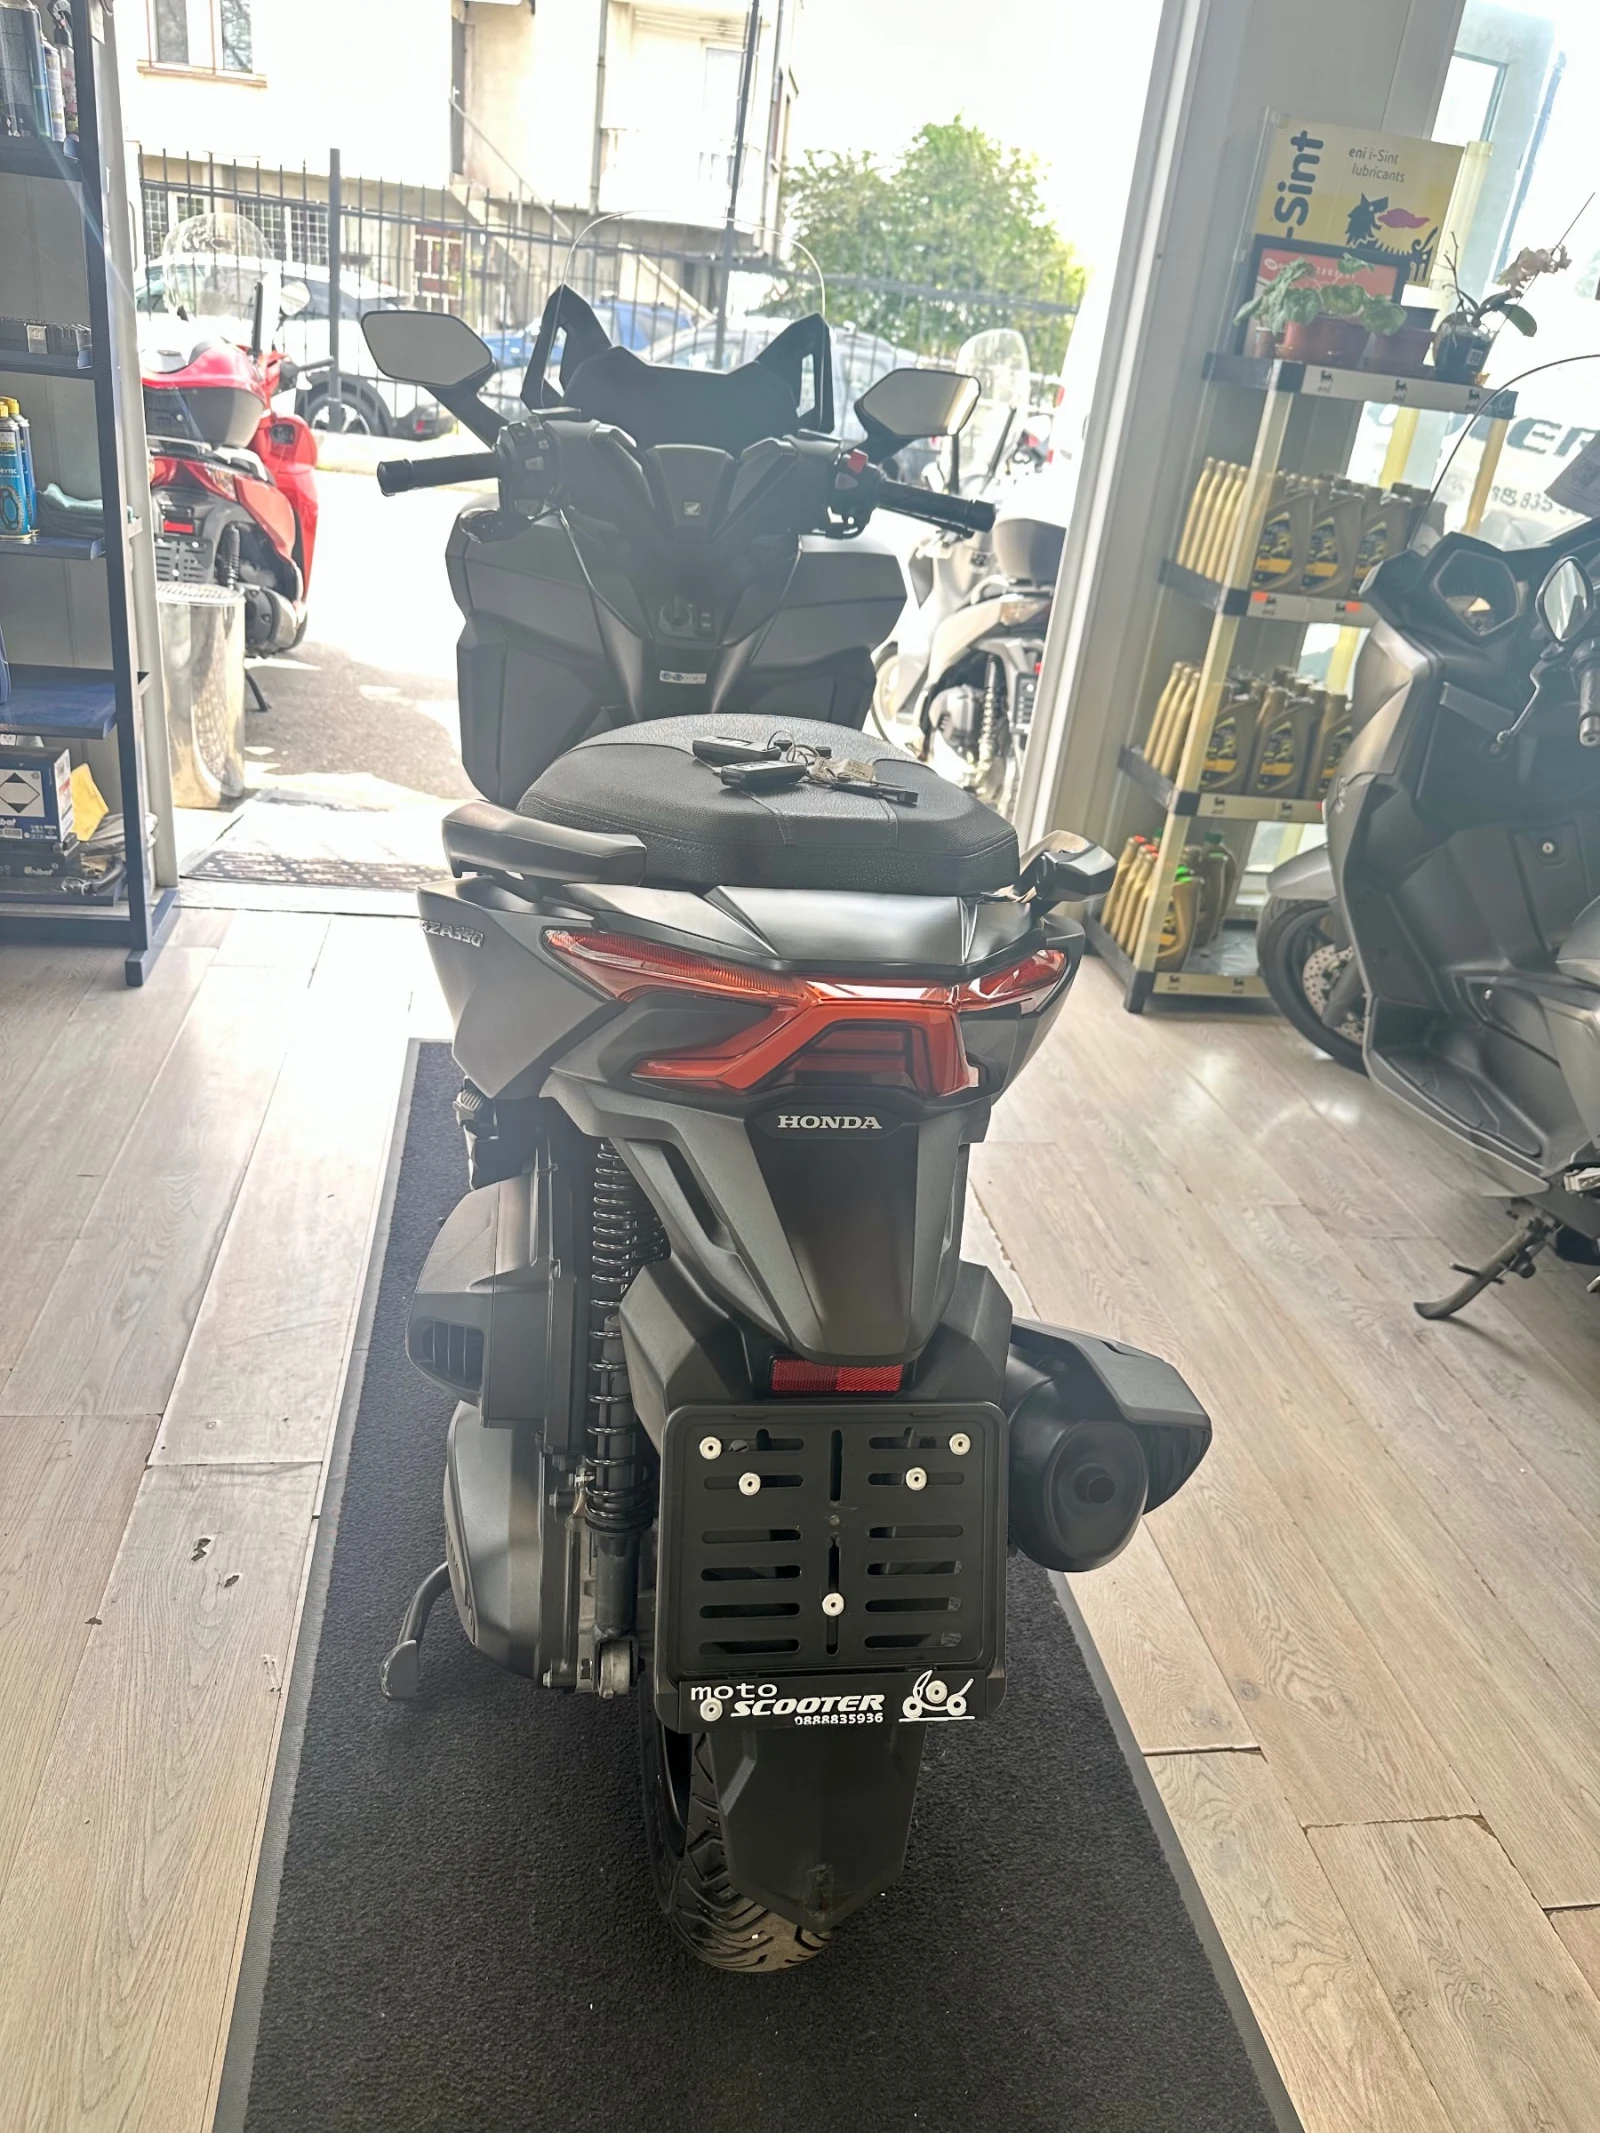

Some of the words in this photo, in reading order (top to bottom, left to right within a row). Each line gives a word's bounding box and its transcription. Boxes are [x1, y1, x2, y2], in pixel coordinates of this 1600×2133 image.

[1348, 146, 1368, 159] eni
[1368, 148, 1399, 165] i-Sint
[1351, 162, 1406, 184] lubricants
[1273, 129, 1325, 239] -Sint
[0, 818, 16, 826] bat
[777, 1115, 883, 1130] HONDA
[690, 1682, 778, 1701] moto
[731, 1694, 884, 1717] SCOOTER
[795, 1713, 883, 1726] 0888835936
